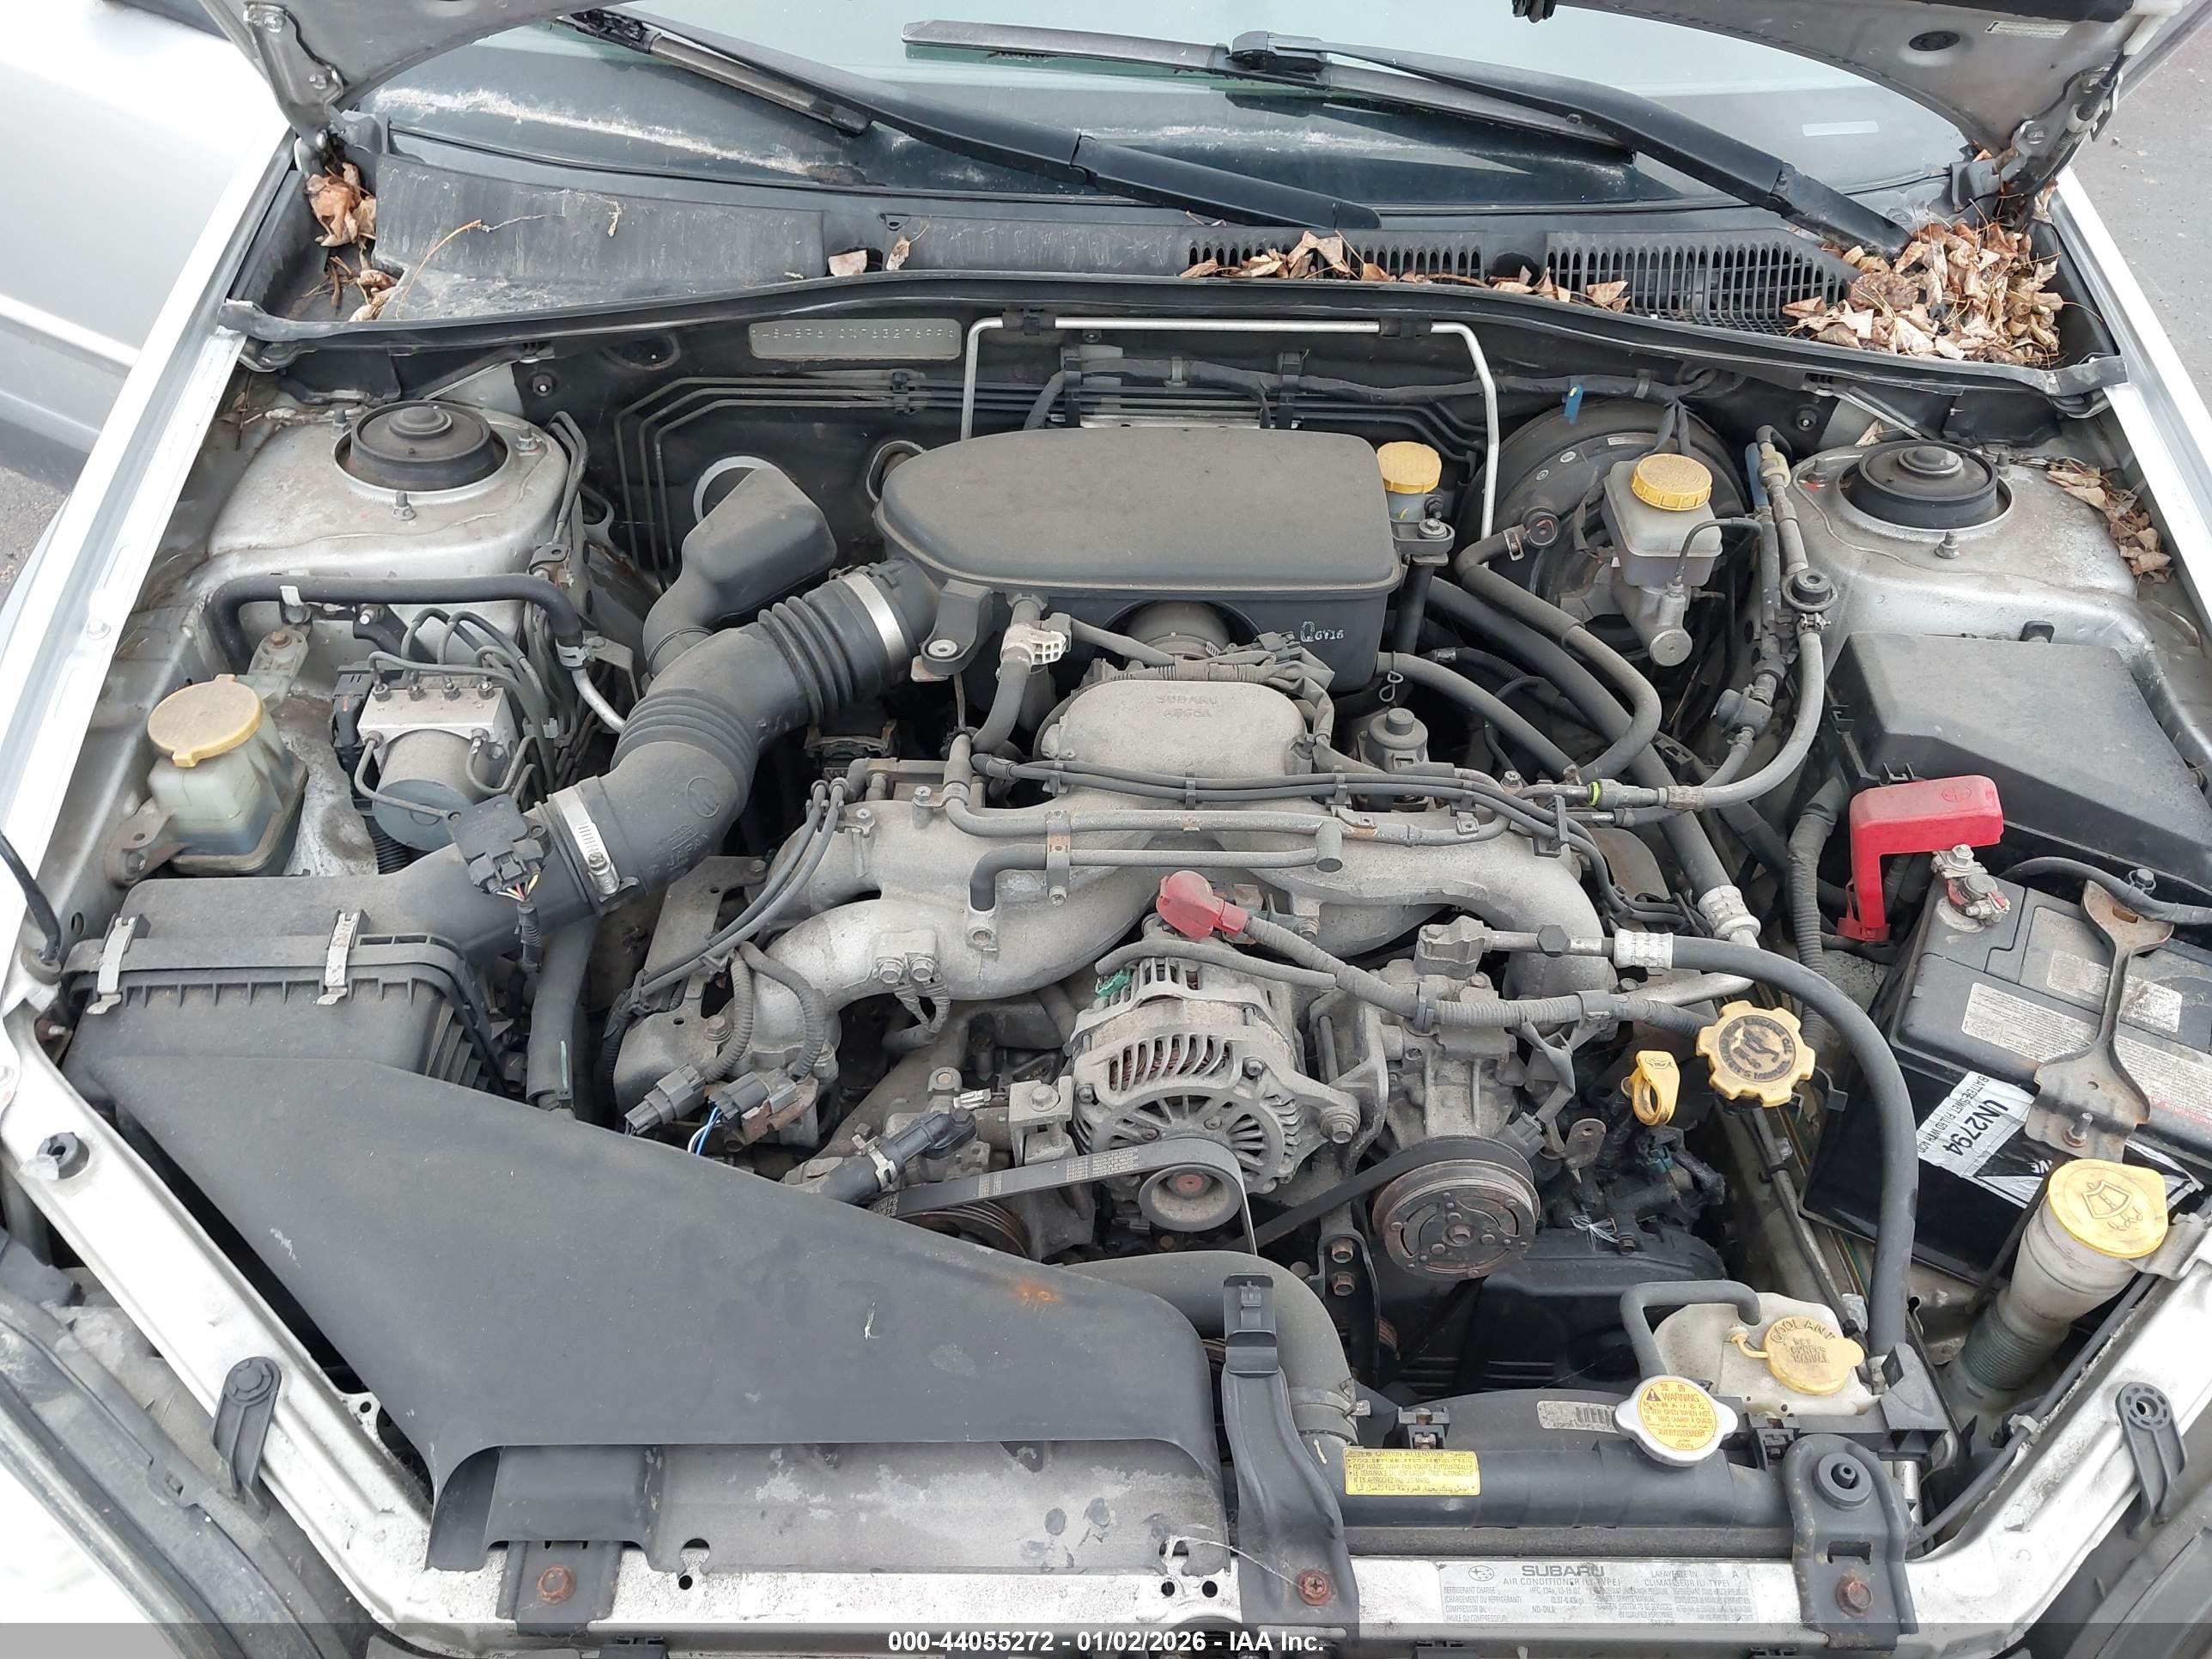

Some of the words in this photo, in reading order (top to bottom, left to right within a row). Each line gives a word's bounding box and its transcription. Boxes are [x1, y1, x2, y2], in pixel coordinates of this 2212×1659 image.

[1942, 1099, 2008, 1157] UN2794
[1770, 1319, 1836, 1343] COOLANT
[1662, 1393, 1699, 1402] WARNING
[1522, 1565, 1605, 1577] SUBARU
[1732, 1570, 1739, 1579] A
[1520, 1578, 1580, 1587] CONDITIONER
